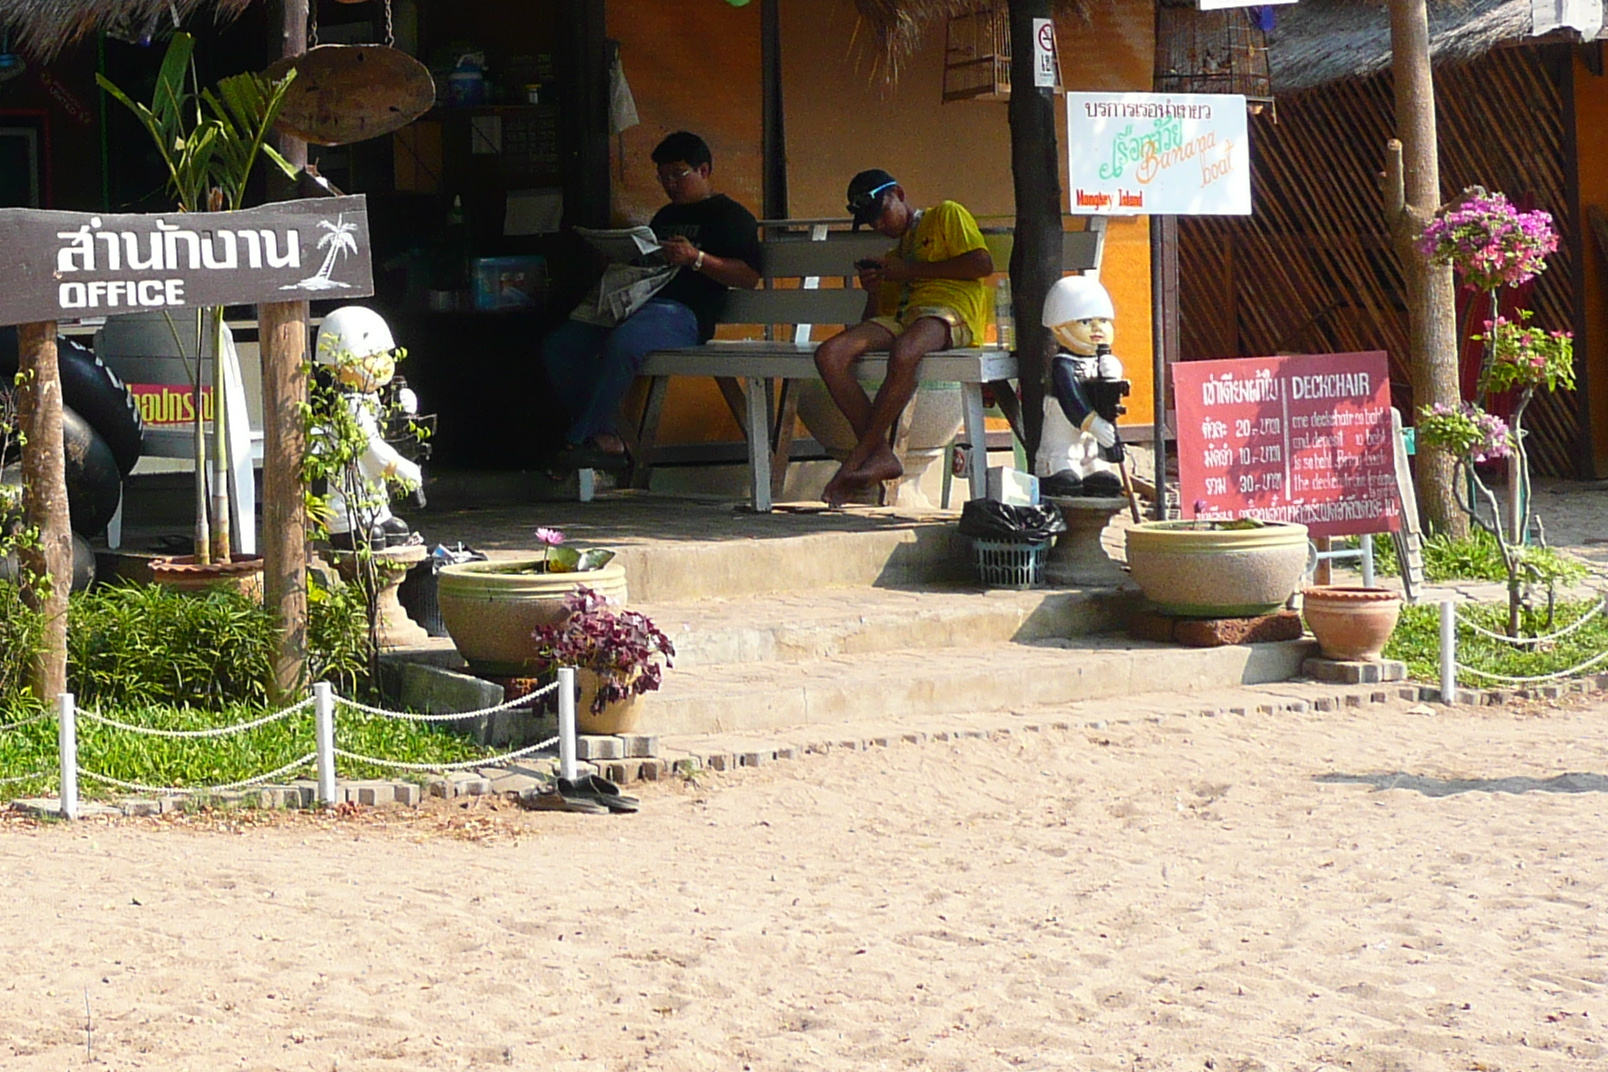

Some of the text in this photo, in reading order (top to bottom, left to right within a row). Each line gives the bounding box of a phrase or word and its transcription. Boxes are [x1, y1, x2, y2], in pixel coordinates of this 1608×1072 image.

[1135, 130, 1217, 184] Banana
[1199, 139, 1235, 189] boat
[1118, 188, 1143, 208] Island
[55, 216, 301, 272] สำนักงาน
[58, 278, 186, 310] OFFICE
[1291, 372, 1370, 400] DECKCHAIR
